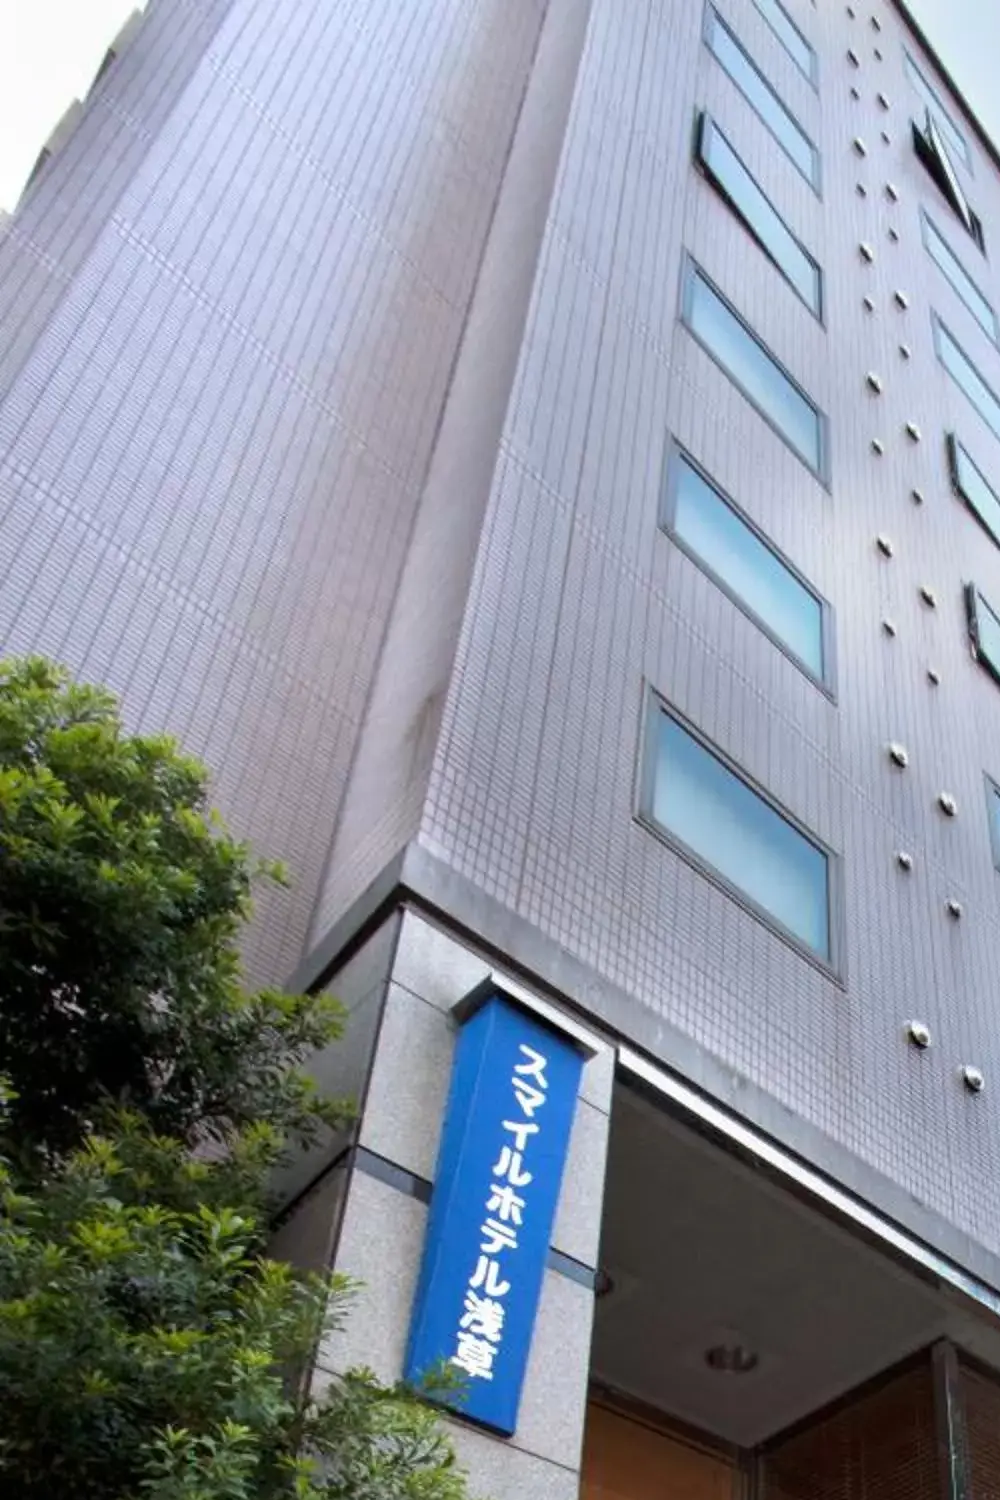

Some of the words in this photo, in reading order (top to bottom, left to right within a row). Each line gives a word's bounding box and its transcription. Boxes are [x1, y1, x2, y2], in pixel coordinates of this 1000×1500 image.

[450, 1043, 548, 1382] スマイルホテル浅草
